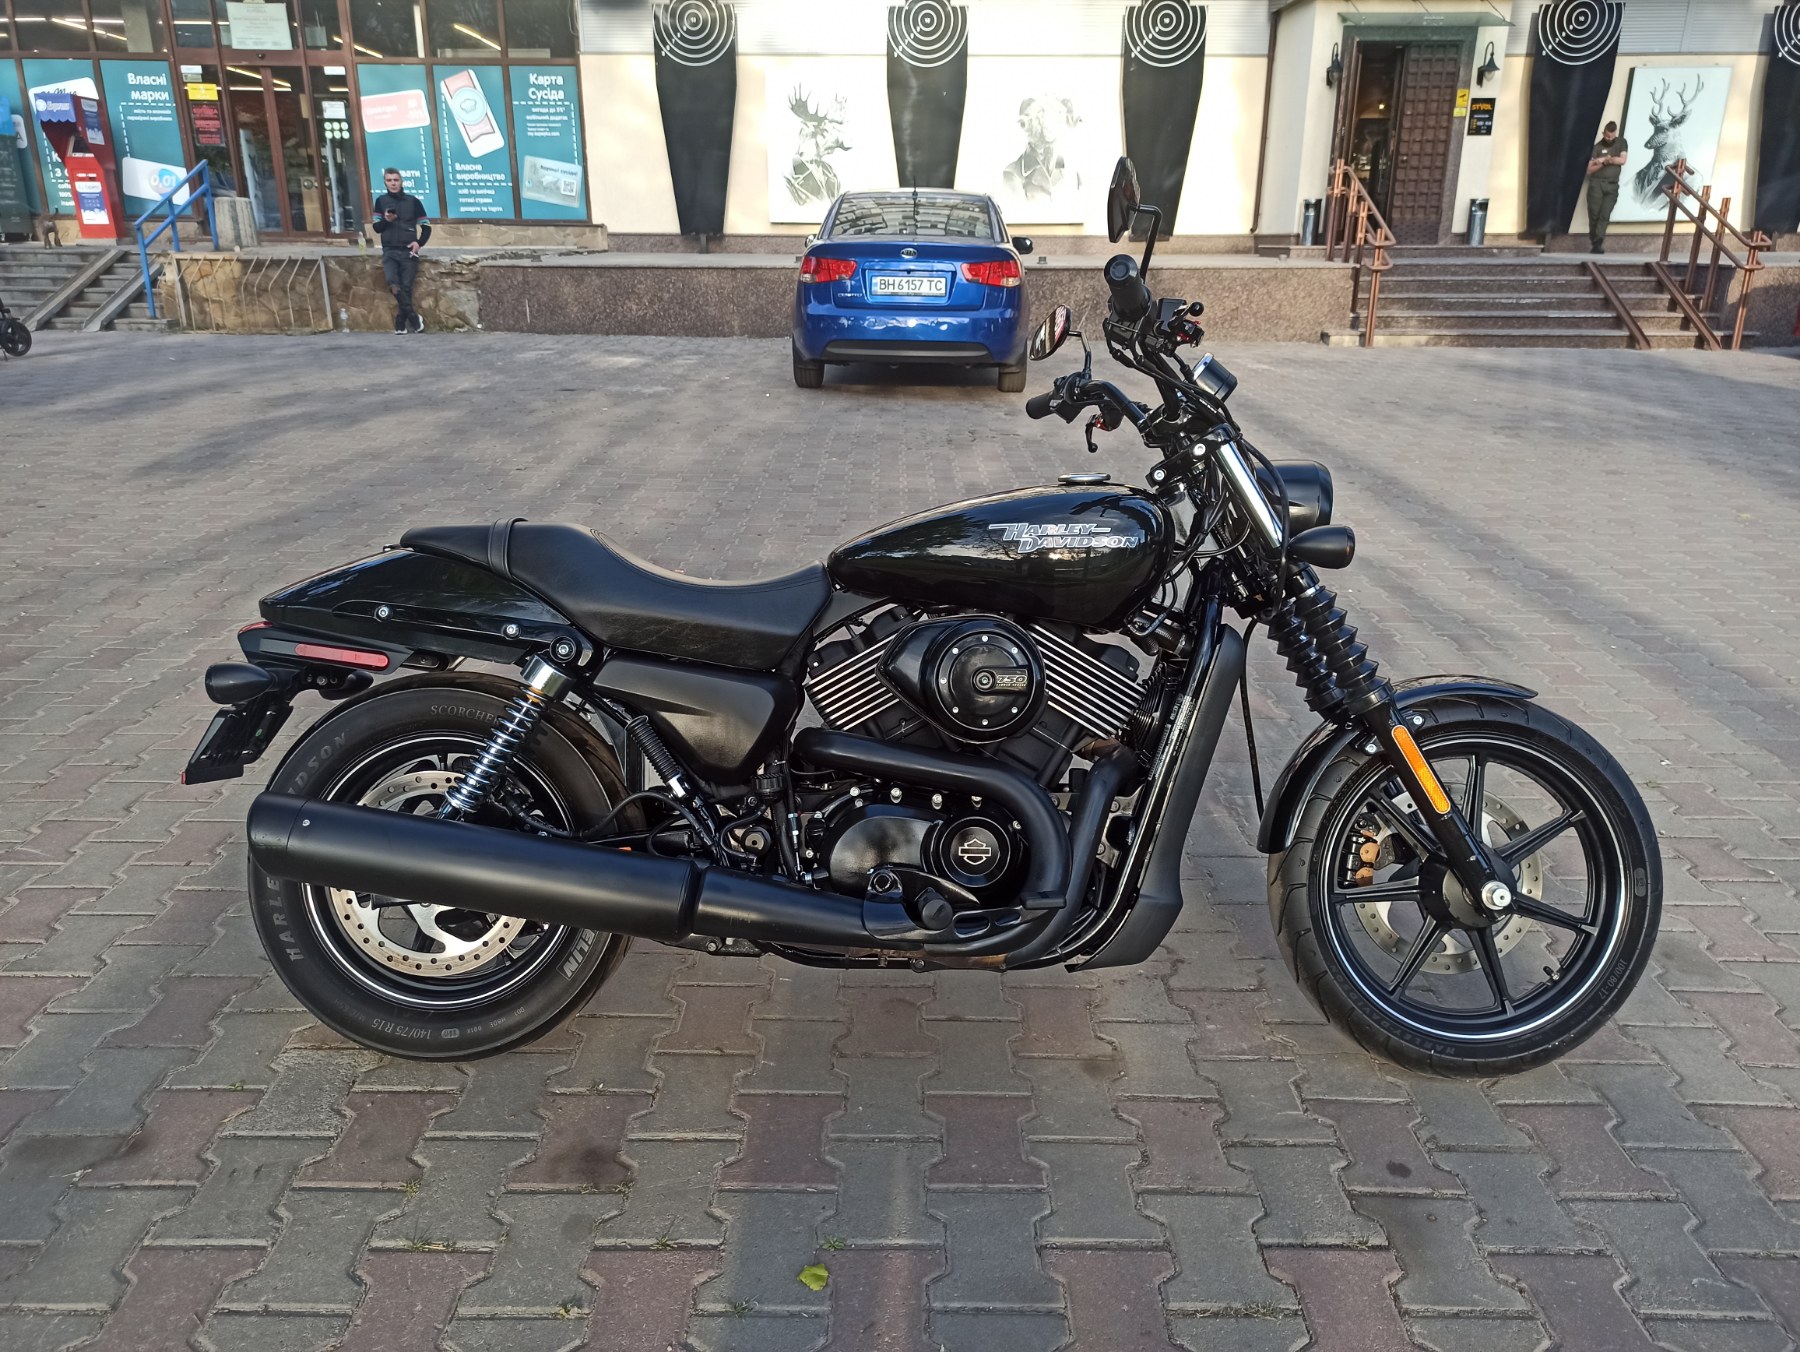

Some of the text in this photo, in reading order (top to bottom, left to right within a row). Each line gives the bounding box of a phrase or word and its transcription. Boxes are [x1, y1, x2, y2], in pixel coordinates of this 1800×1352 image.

[127, 73, 167, 85] Власні
[529, 73, 564, 87] Карта
[131, 91, 169, 103] марки
[528, 88, 565, 102] Сусіда
[455, 163, 482, 171] Власне
[879, 279, 943, 291] BH 6157 TC
[1017, 536, 1138, 553] DAVIDSON
[996, 675, 1027, 684] 750
[266, 876, 305, 962] HARLE
[563, 929, 595, 977] ELIN
[371, 1018, 396, 1033] R15
[396, 1025, 432, 1040] 140/75
